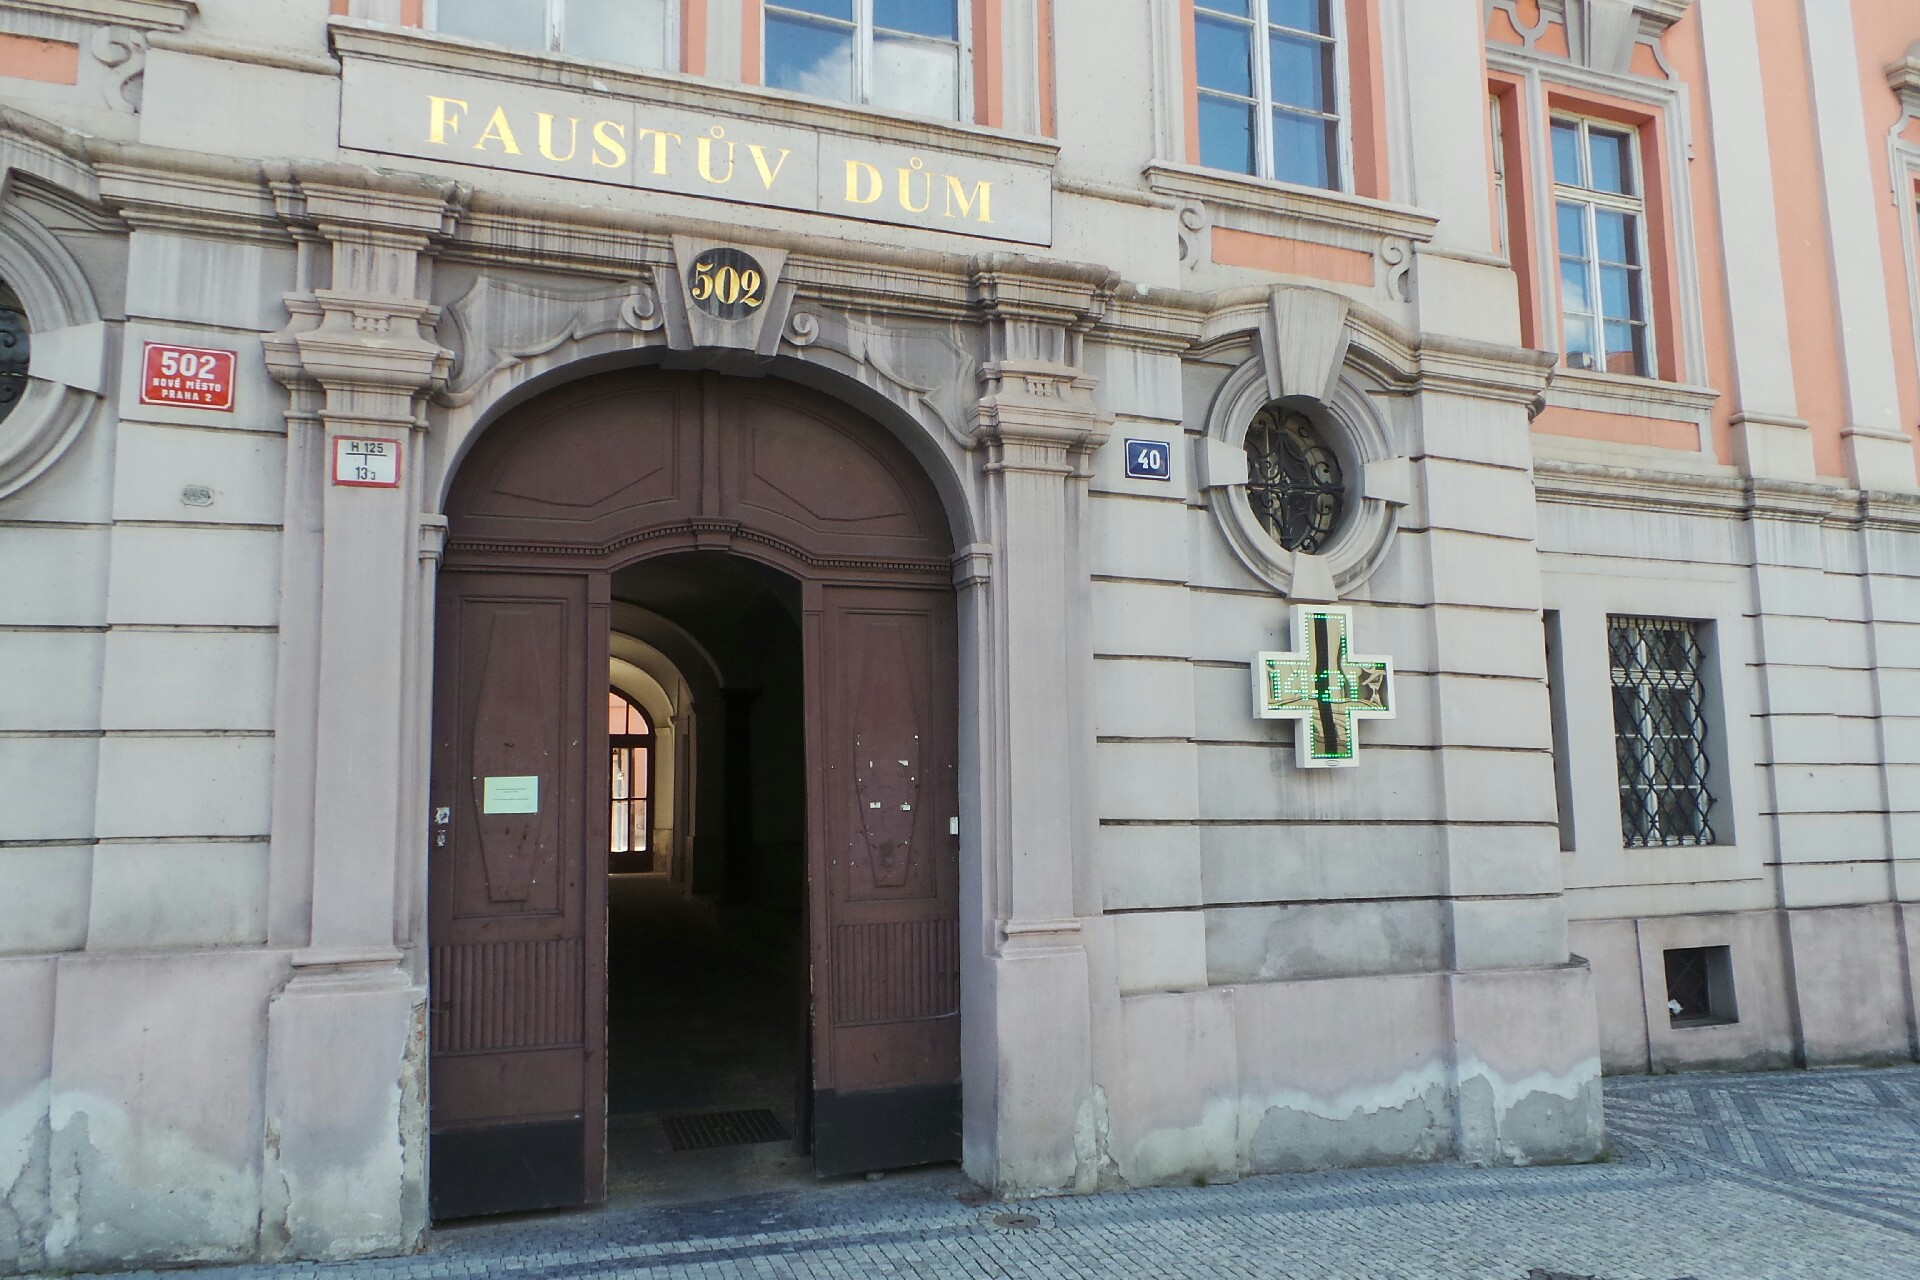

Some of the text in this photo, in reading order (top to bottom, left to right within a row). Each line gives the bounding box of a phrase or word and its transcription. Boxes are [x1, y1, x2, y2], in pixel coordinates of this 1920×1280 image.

[425, 94, 995, 224] FAUSTŮV DŮM
[692, 262, 763, 307] 502
[161, 351, 216, 379] 502
[152, 377, 221, 392] NOVÉ MĚSTO
[161, 389, 212, 402] PRAHA 2
[351, 441, 384, 454] H 125
[1137, 448, 1161, 470] 40
[1270, 669, 1358, 702] 14:21
